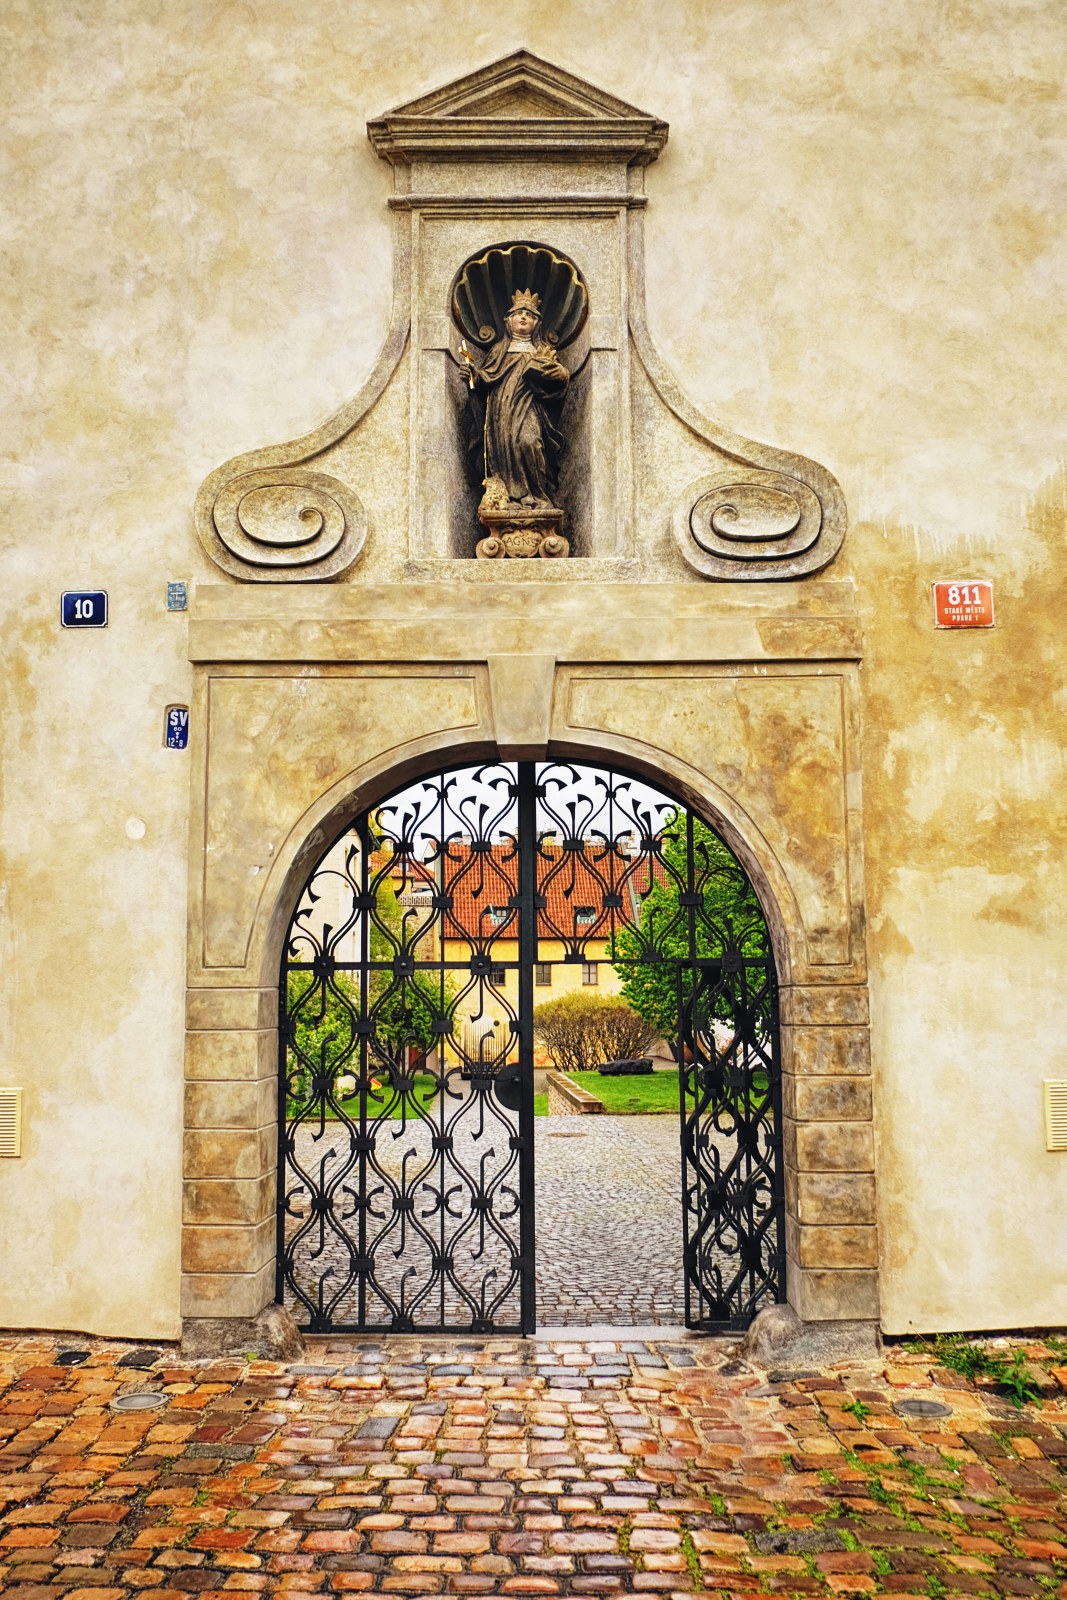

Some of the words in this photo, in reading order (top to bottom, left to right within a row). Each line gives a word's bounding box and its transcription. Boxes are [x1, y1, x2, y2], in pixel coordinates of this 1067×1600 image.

[948, 585, 982, 605] 811
[75, 599, 94, 619] 10
[944, 606, 963, 614] STARÉ
[965, 606, 985, 614] MĚSTO
